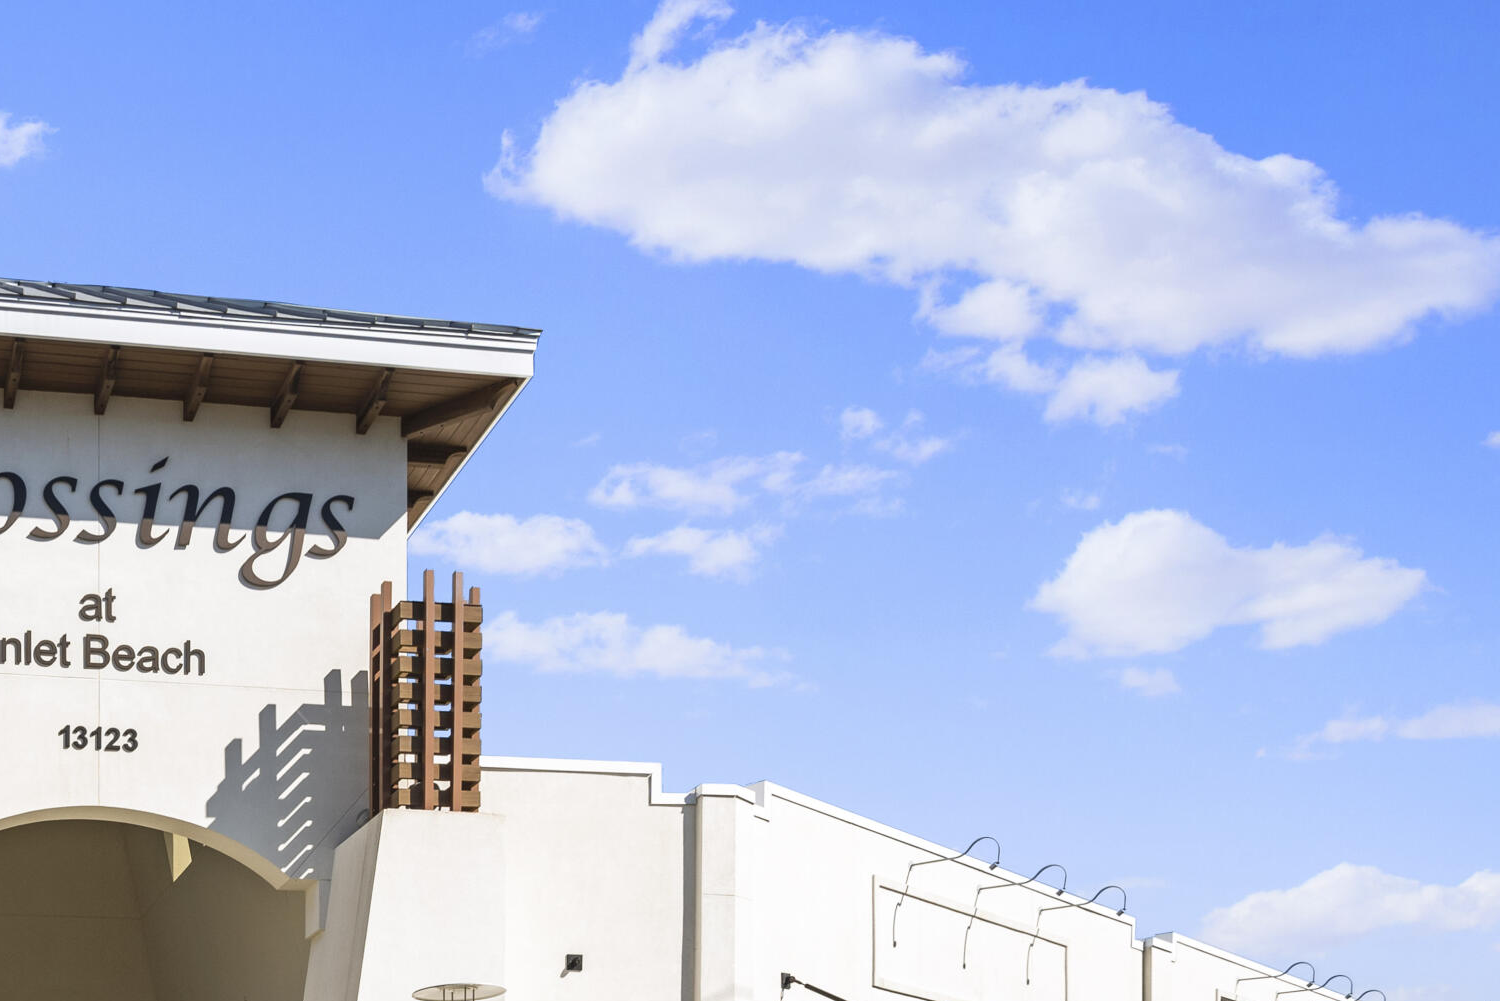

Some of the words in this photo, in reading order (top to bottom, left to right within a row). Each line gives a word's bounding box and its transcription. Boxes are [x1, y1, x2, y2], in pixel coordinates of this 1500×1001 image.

[78, 587, 116, 623] at
[82, 633, 206, 676] Beach
[57, 724, 139, 753] 13123
